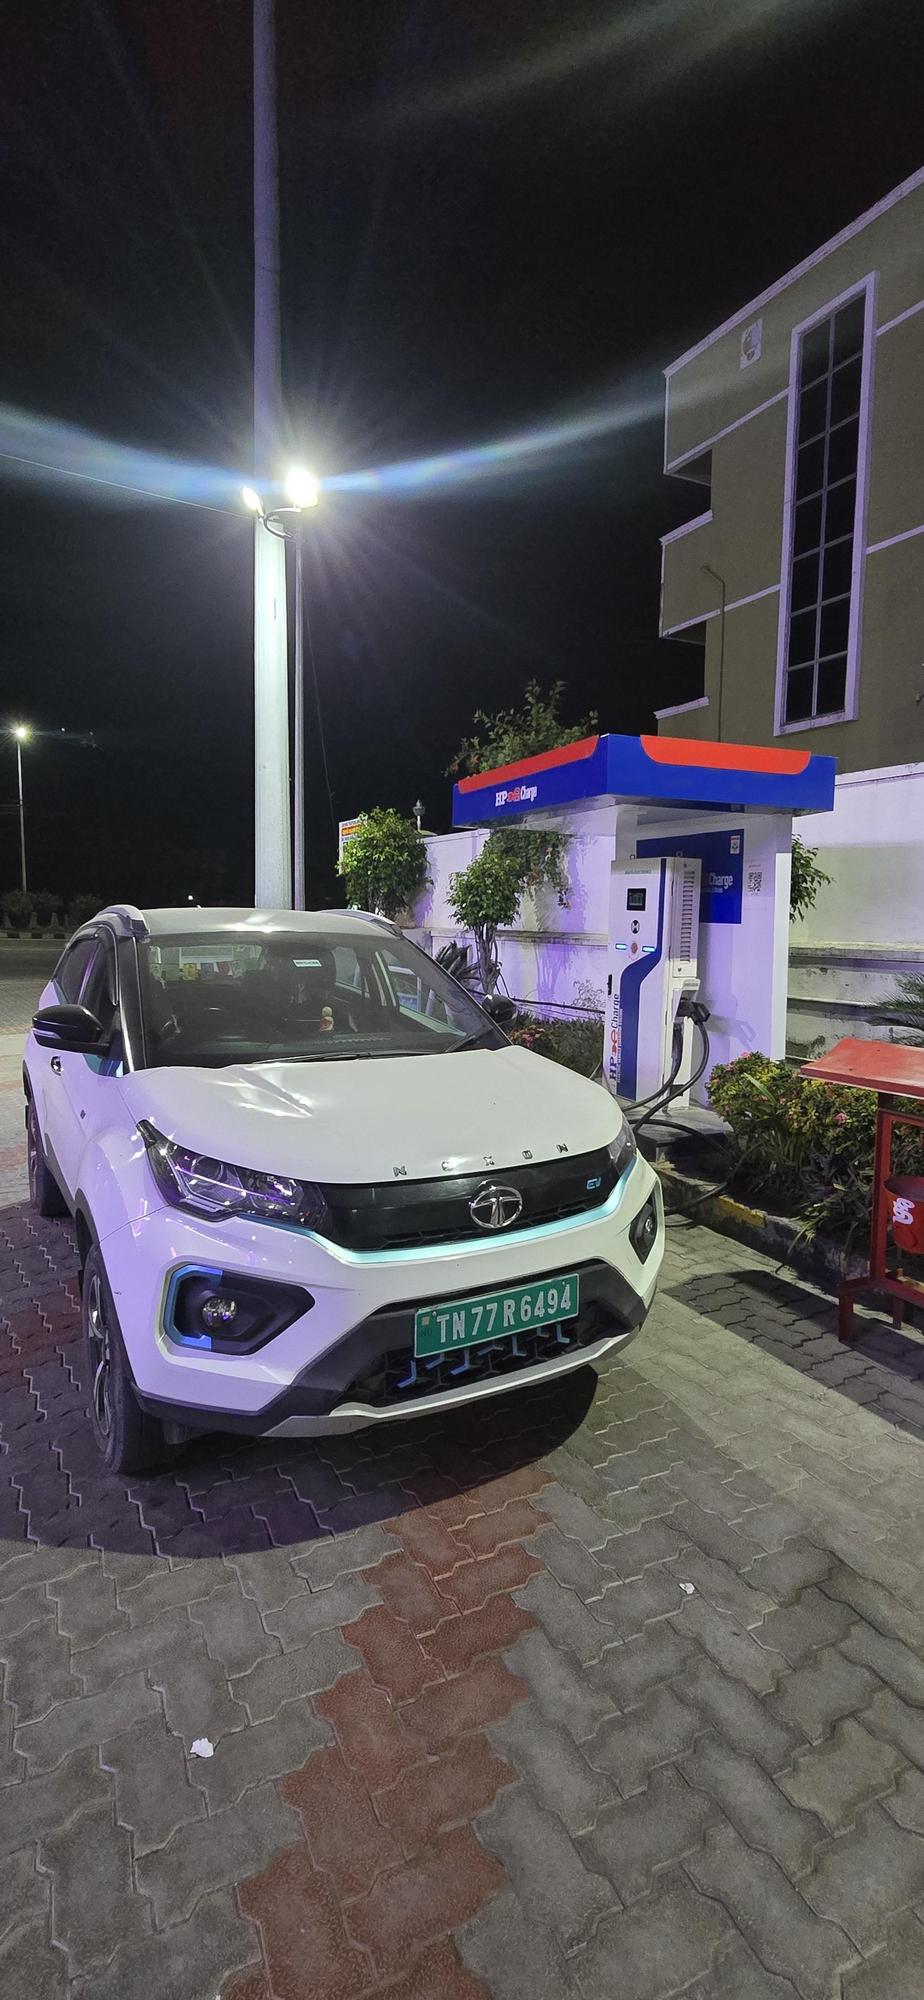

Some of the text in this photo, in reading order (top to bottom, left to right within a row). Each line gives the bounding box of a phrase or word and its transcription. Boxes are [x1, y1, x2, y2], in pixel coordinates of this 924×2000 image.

[495, 790, 508, 807] HP
[708, 872, 734, 889] Charge
[611, 993, 619, 1029] Charge
[609, 1056, 617, 1081] HP
[586, 1177, 602, 1190] EV
